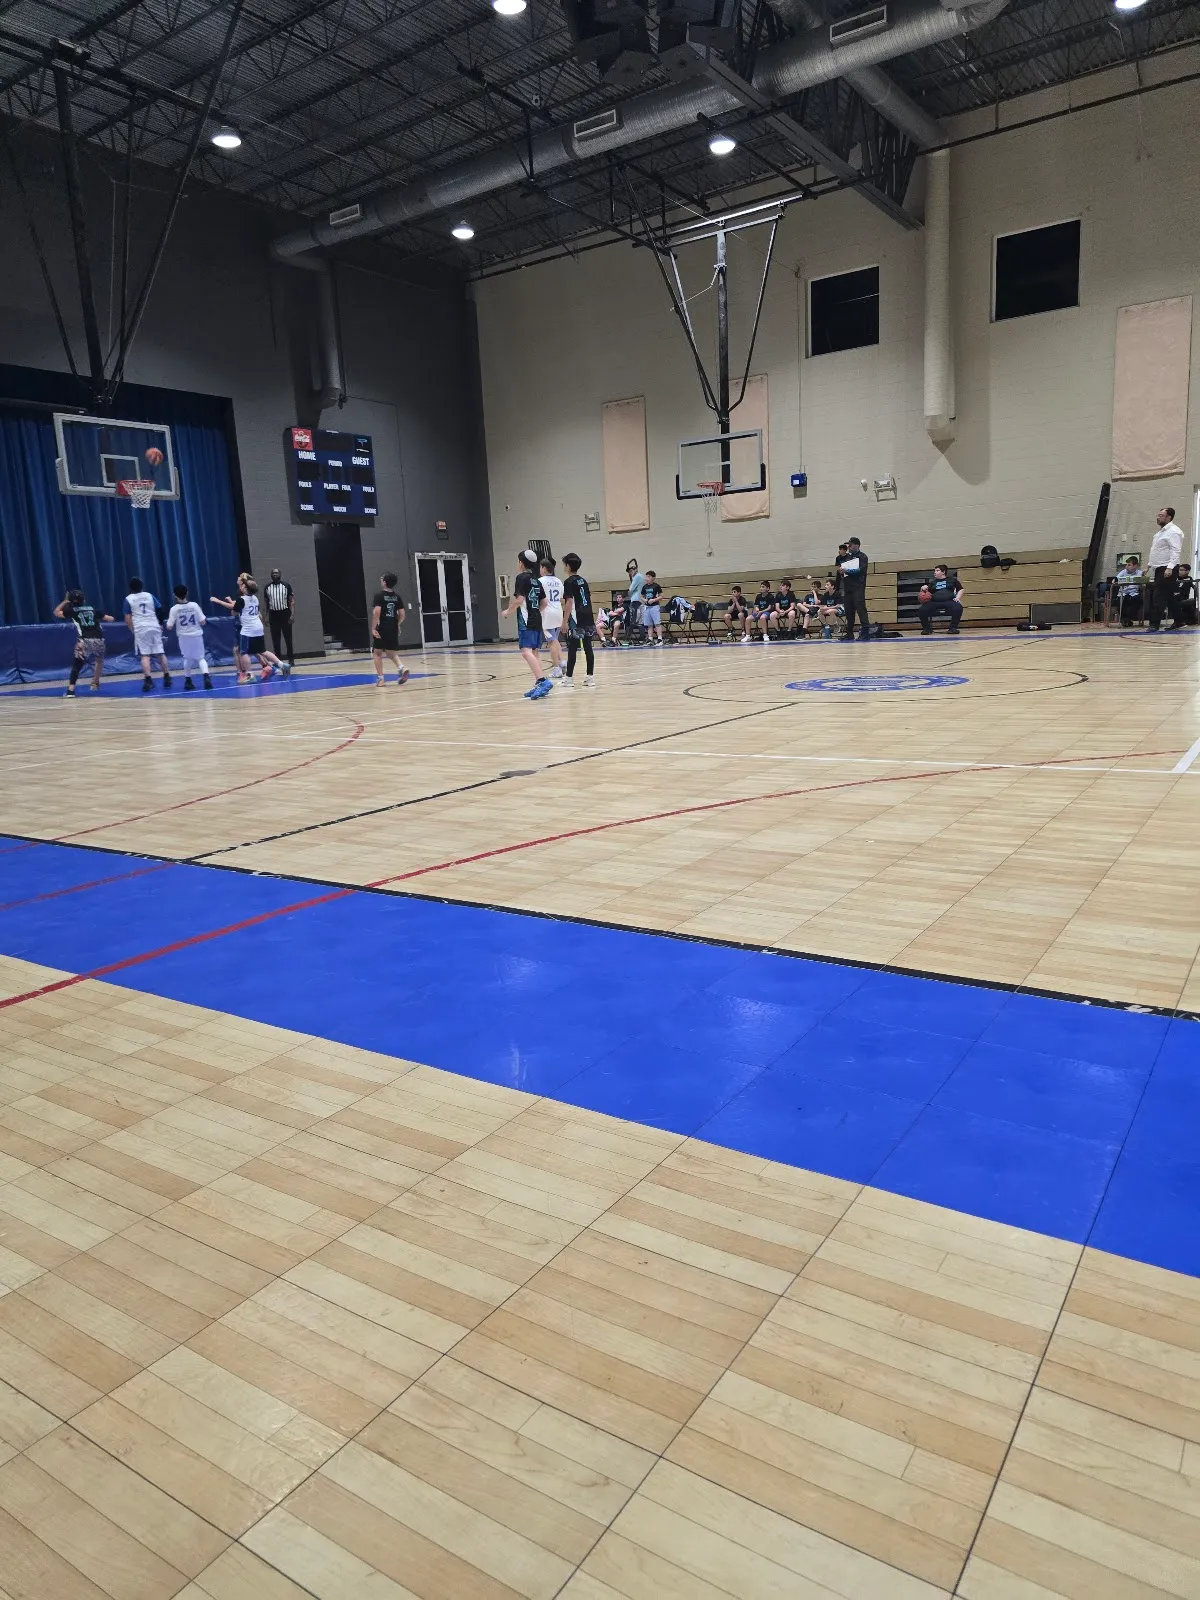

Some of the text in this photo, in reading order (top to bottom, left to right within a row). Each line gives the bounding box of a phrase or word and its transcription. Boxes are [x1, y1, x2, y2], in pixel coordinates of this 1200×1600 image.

[298, 450, 317, 461] HOME
[351, 456, 370, 466] GUEST
[549, 588, 560, 602] 12
[139, 602, 146, 614] 7
[178, 613, 197, 627] 24
